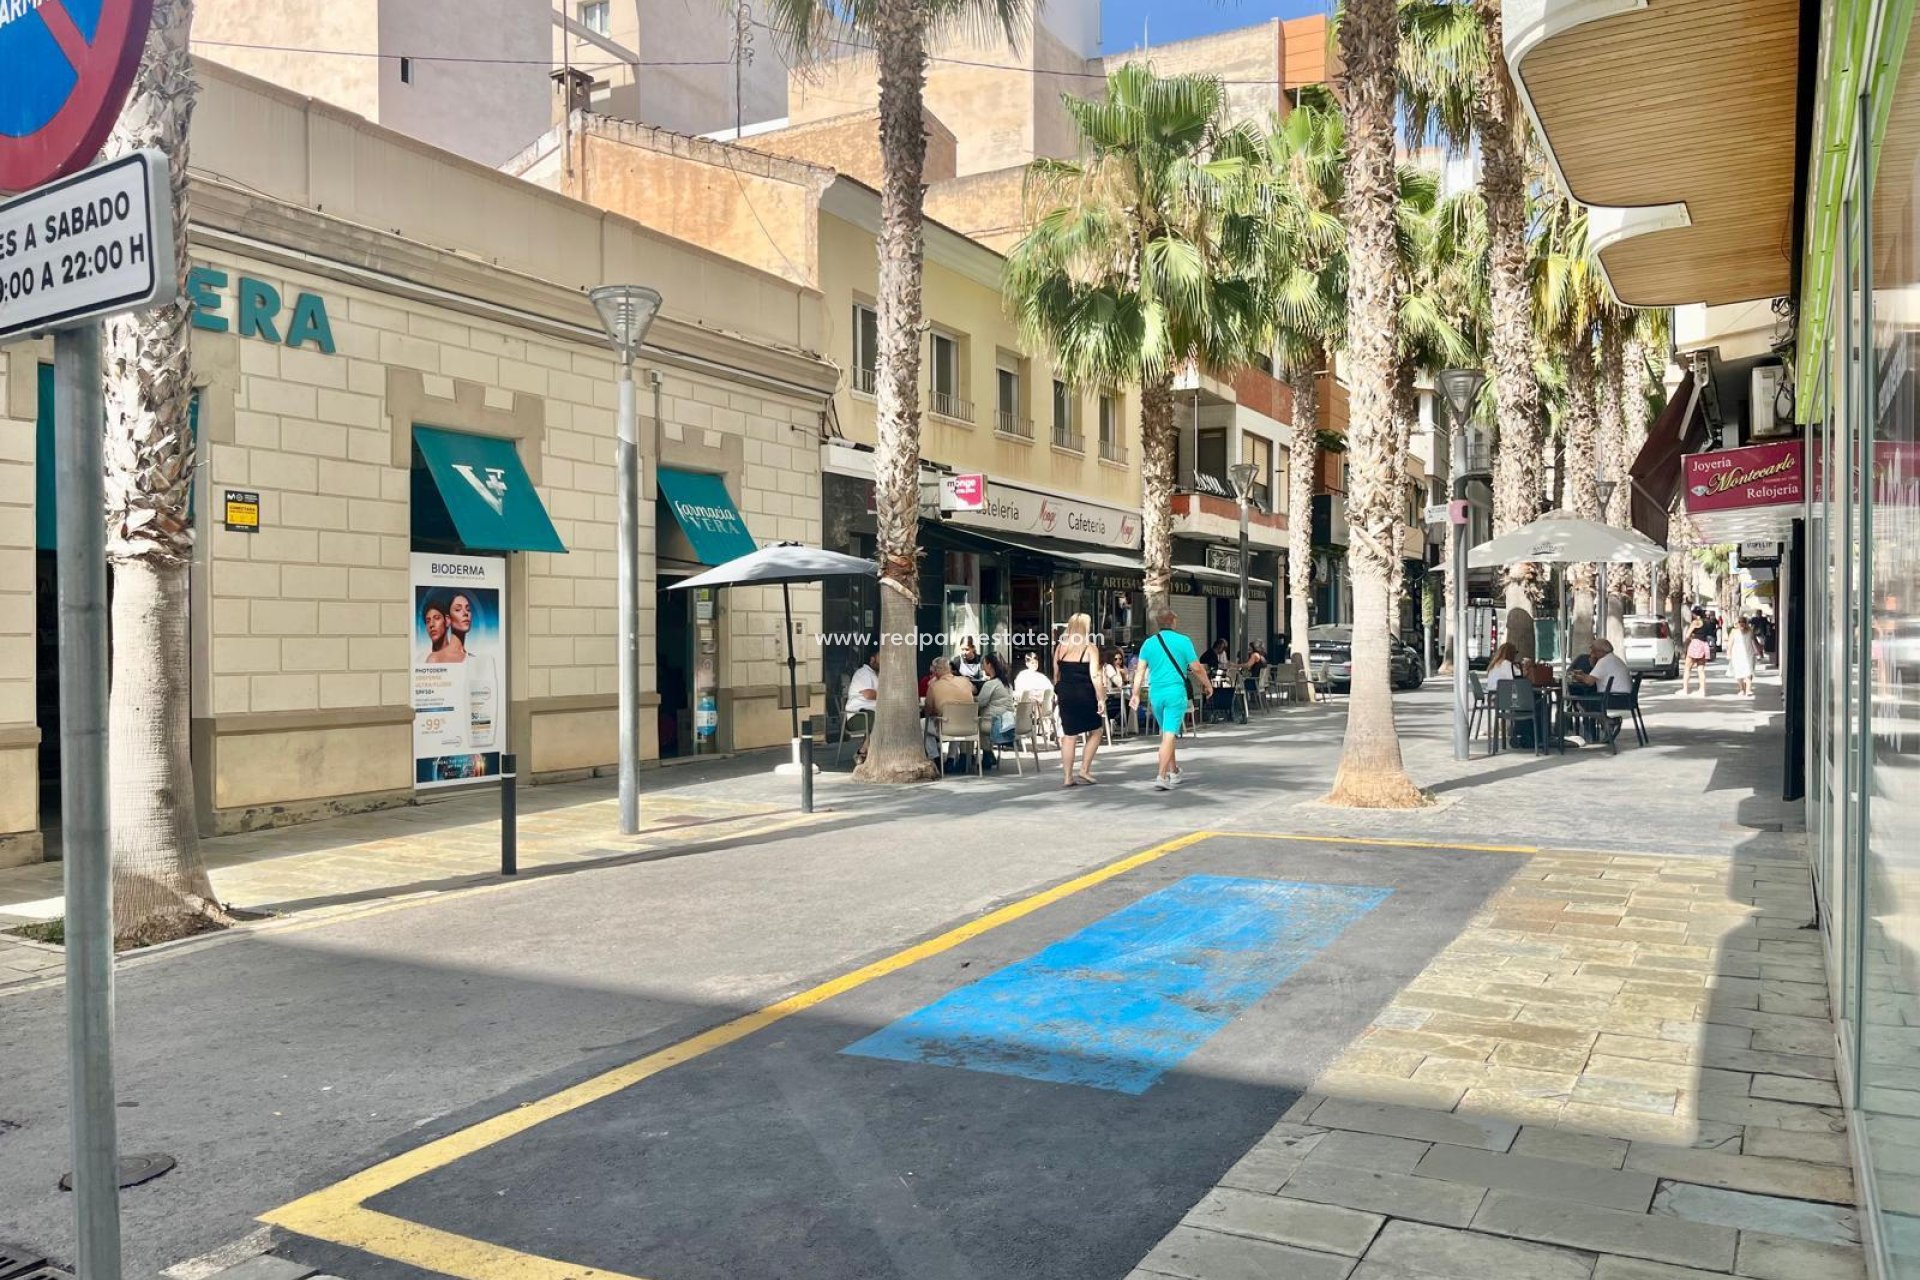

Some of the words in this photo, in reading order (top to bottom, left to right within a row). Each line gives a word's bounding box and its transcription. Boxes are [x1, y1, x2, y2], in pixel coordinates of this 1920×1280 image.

[24, 222, 37, 251] A
[45, 190, 130, 243] SABADO
[41, 261, 54, 291] A
[61, 240, 123, 284] 22:00
[130, 233, 145, 265] H
[186, 266, 336, 355] ERA
[1693, 457, 1732, 473] Joyería
[1705, 452, 1796, 496] Montecarlo
[1746, 483, 1799, 499] Relojería
[689, 516, 741, 535] VERA
[431, 562, 486, 576] BIODERMA
